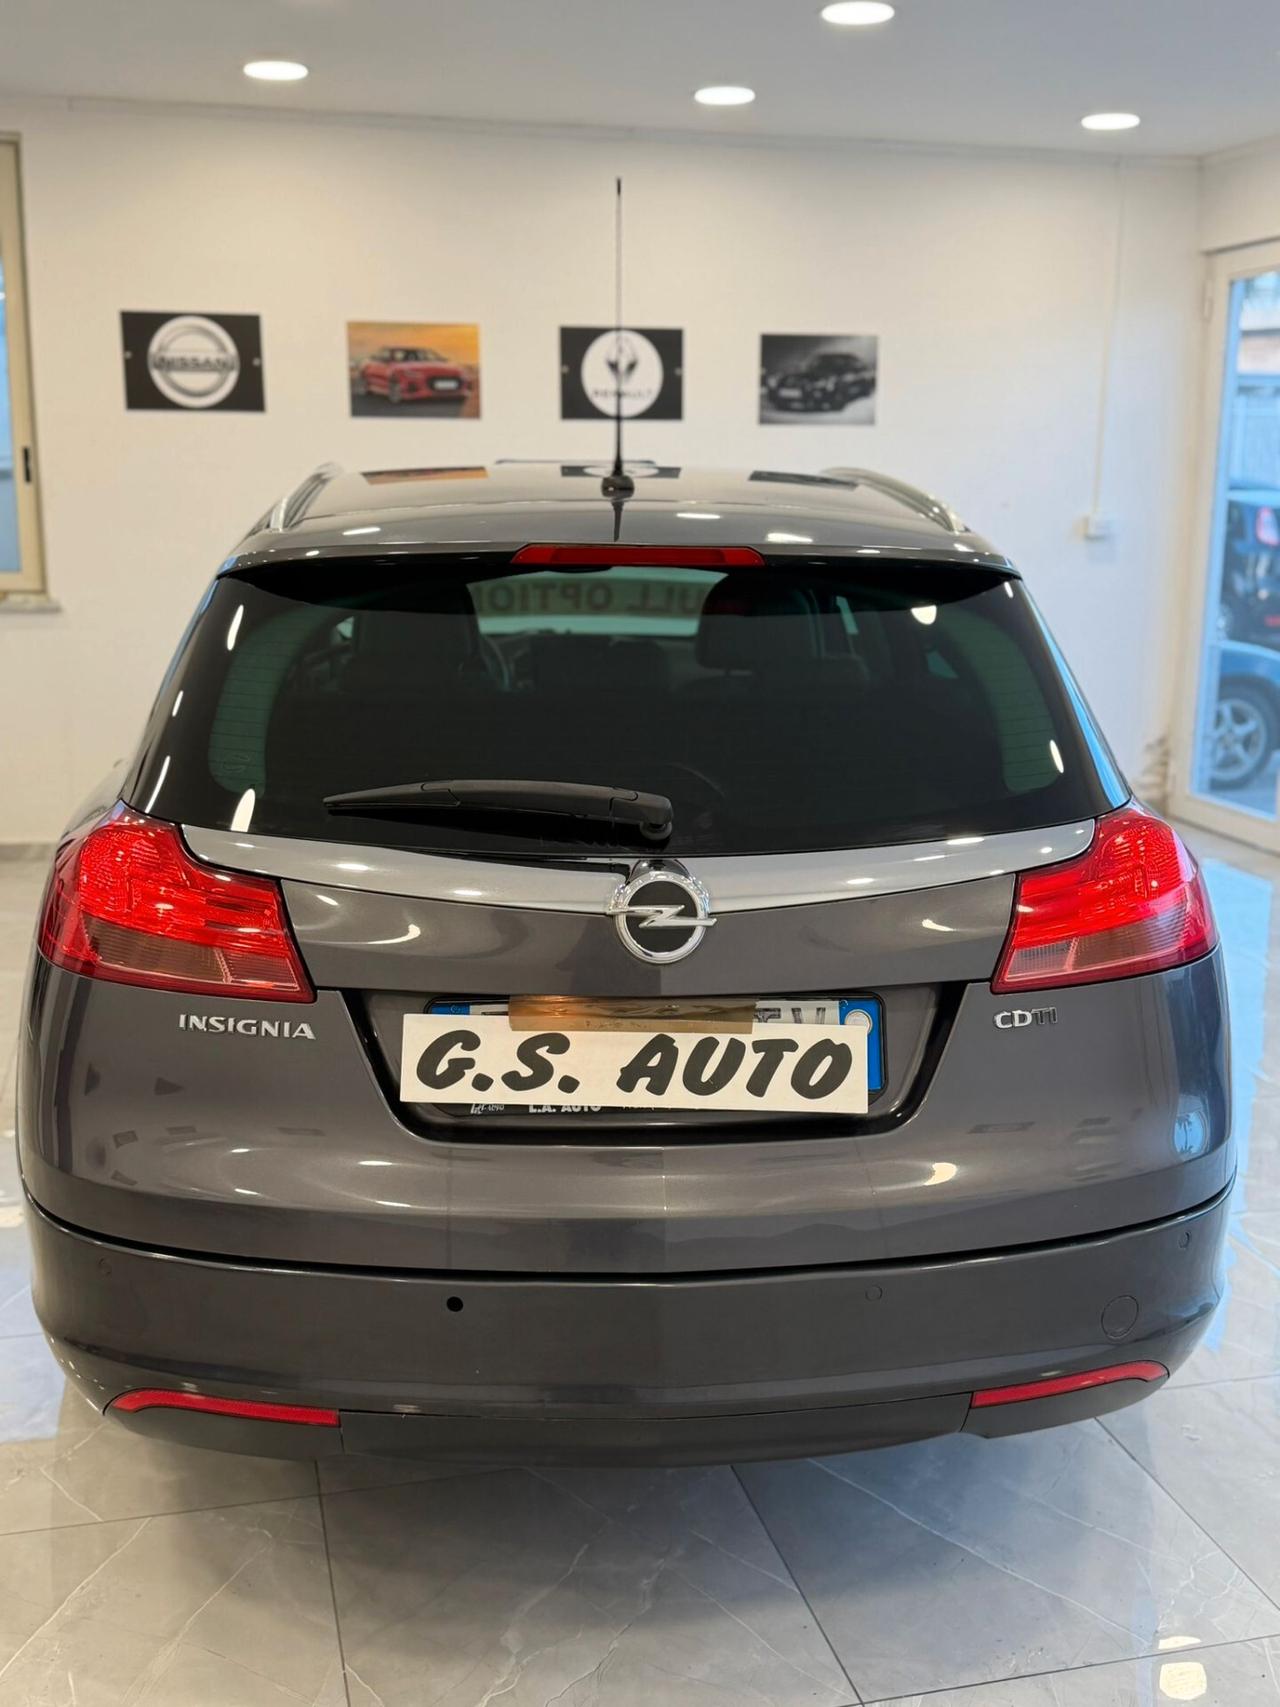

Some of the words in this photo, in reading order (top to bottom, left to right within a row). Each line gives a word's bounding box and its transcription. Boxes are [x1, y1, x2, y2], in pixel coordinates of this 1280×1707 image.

[153, 355, 234, 371] NISSAN
[178, 1013, 317, 1041] INSIGNIA
[415, 1028, 581, 1094] G.S.
[616, 1032, 854, 1100] AUTO
